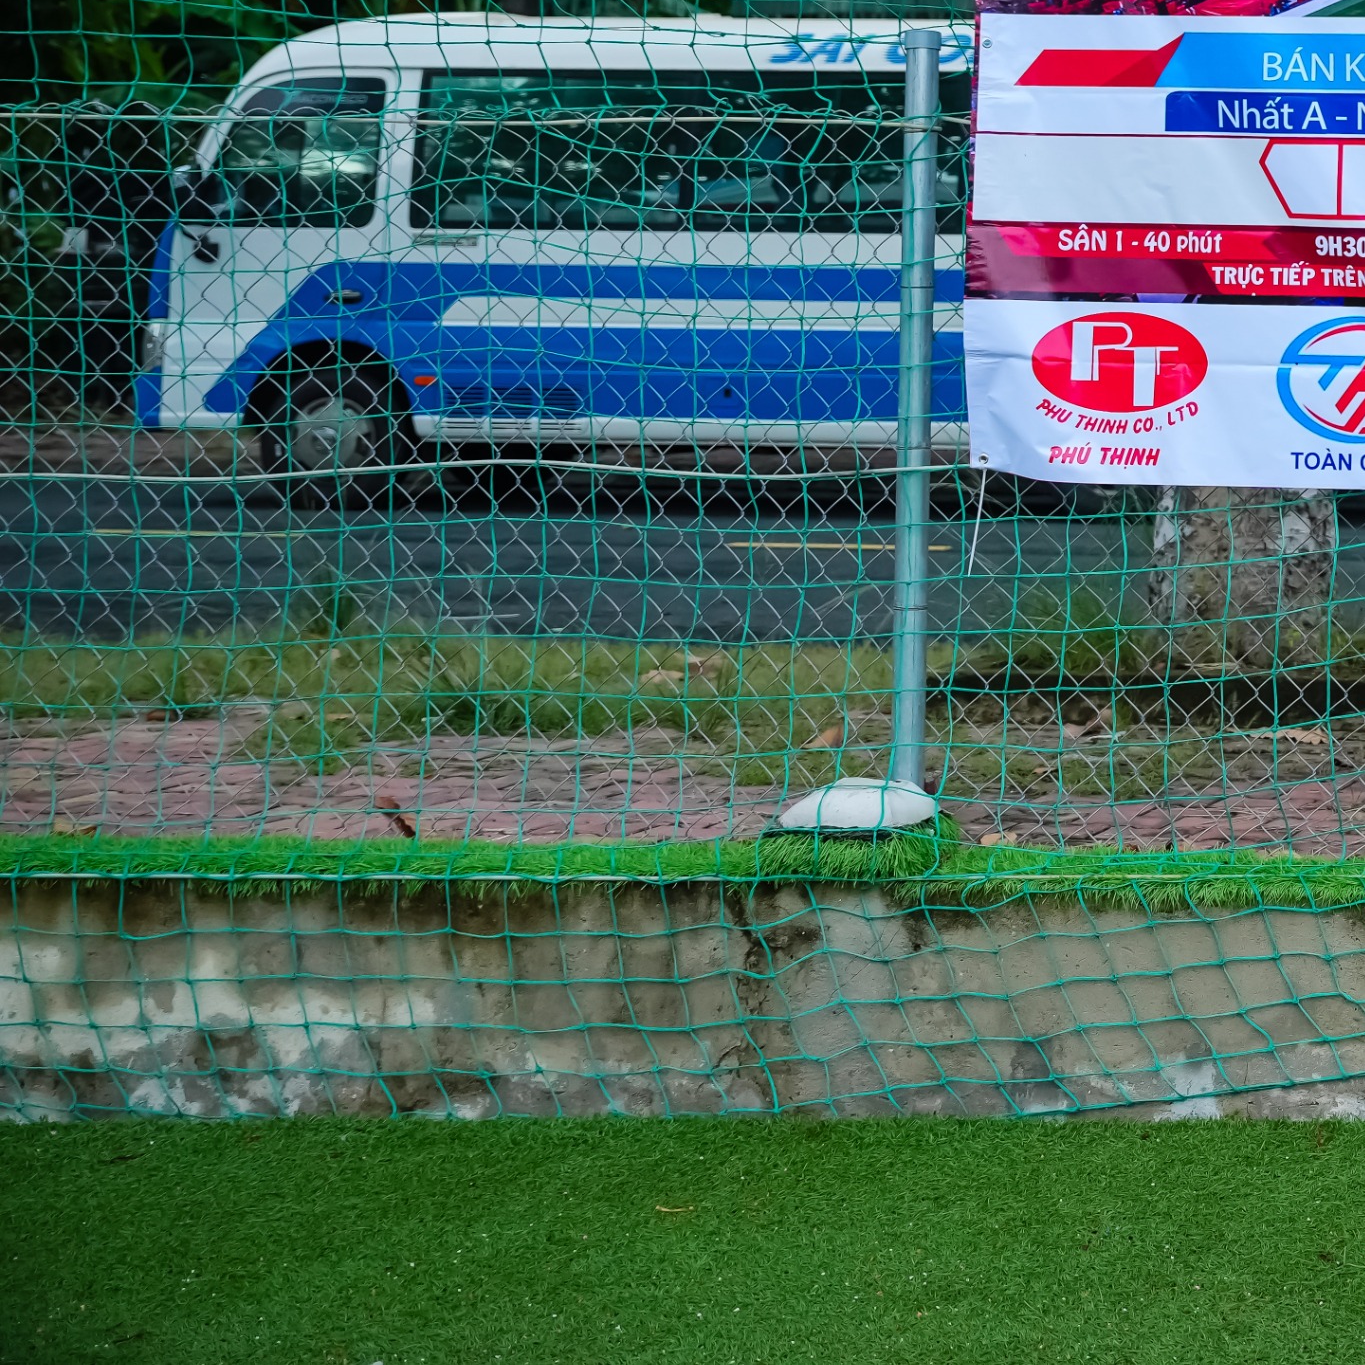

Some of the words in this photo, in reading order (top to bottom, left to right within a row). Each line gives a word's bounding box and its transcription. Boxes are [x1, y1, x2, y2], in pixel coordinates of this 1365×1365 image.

[1263, 50, 1335, 83] BÁN
[1217, 97, 1296, 131] Nhất
[1301, 105, 1327, 130] A
[1212, 265, 1264, 290] TRỰC
[1271, 261, 1315, 287] TIẾP
[1036, 398, 1073, 423] PHU
[1075, 414, 1128, 434] THINH
[1167, 401, 1199, 426] LTD
[1048, 442, 1092, 464] PHÚ
[1100, 447, 1161, 469] THỊNH
[1290, 447, 1353, 474] TOÀN
